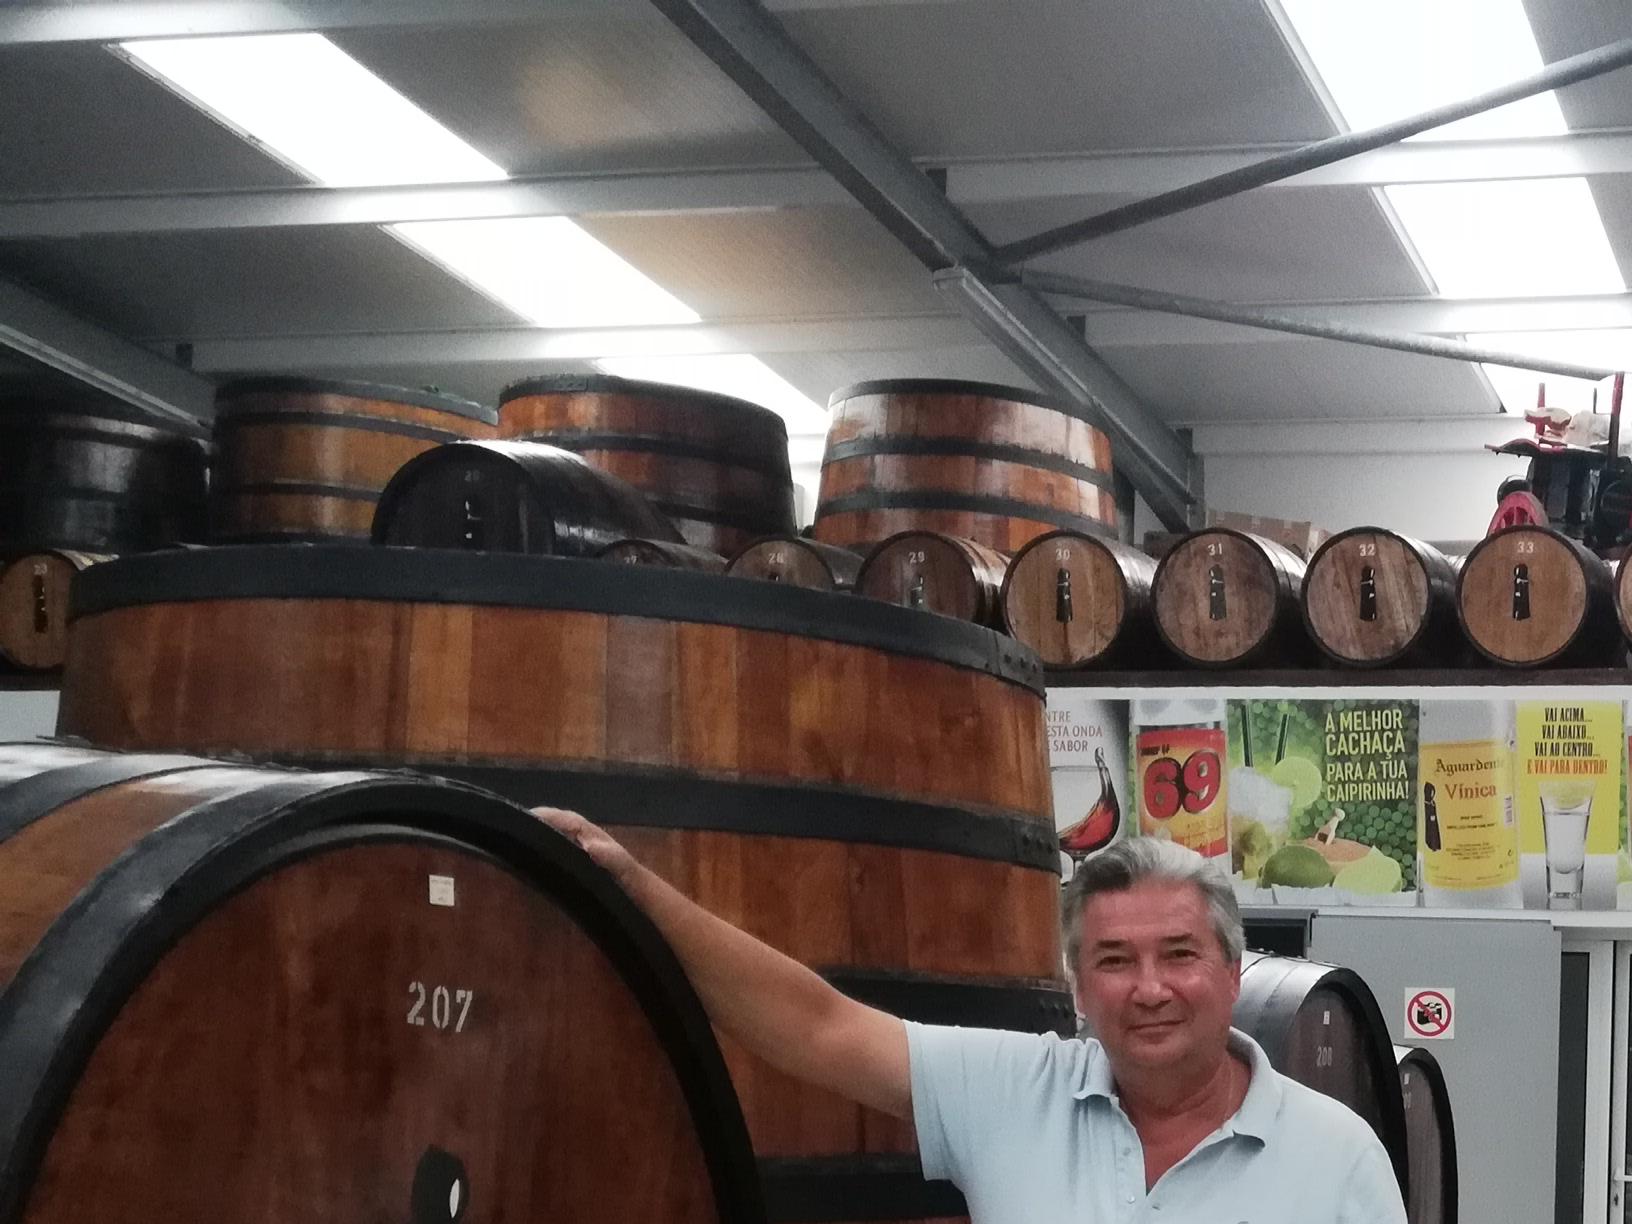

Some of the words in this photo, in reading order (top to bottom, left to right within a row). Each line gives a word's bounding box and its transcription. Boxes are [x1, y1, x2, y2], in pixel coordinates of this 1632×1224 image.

[1055, 548, 1071, 561] 30
[1208, 543, 1223, 556] 31
[1359, 544, 1375, 557] 32
[1517, 541, 1534, 554] 33
[909, 551, 925, 564] 29
[34, 563, 48, 575] 23
[1046, 710, 1071, 722] NTRE
[1325, 711, 1336, 733] A
[1340, 708, 1403, 732] MELHOR
[1545, 707, 1558, 722] VAI
[1046, 725, 1069, 737] ESTA
[1072, 725, 1103, 737] ONDA
[1542, 725, 1554, 739] VAI
[1053, 740, 1089, 752] SABOR
[1326, 730, 1406, 759] CACHAÇA
[1535, 742, 1547, 756] VAI
[1550, 742, 1560, 756] AO
[1327, 761, 1364, 781] PARA
[1367, 761, 1377, 780] A
[1380, 759, 1408, 779] TUA
[1535, 760, 1547, 774] VAI
[1550, 760, 1570, 774] PARA
[1573, 760, 1608, 774] DENTRO!
[1143, 748, 1221, 820] 69
[1327, 780, 1409, 802] CAIPIRINHA!
[1444, 782, 1497, 800] Vínica
[407, 981, 473, 1033] 207
